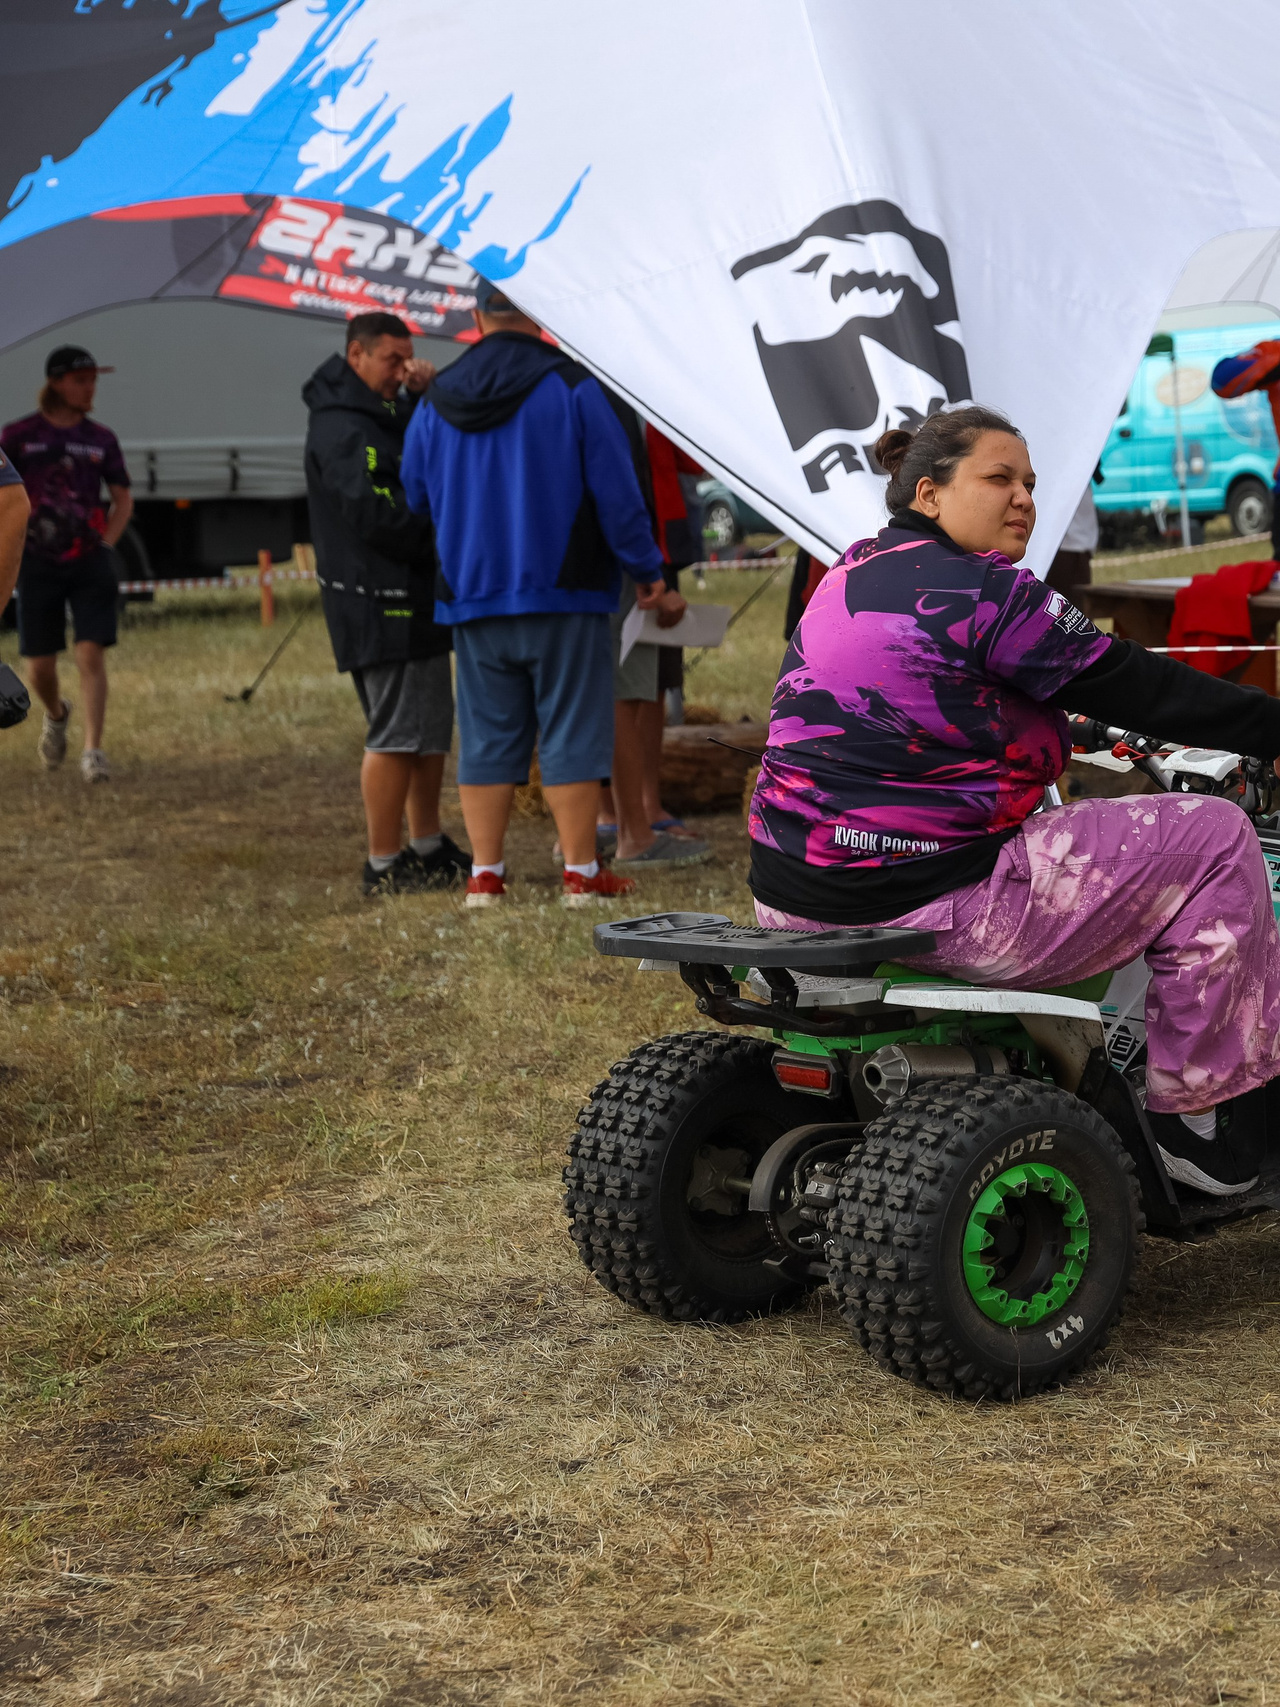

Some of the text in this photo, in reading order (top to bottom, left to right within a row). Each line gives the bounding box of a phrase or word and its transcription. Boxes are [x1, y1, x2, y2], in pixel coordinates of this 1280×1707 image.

[834, 825, 940, 854] КУБОК РОССИИ
[968, 1129, 1057, 1201] COYOTE
